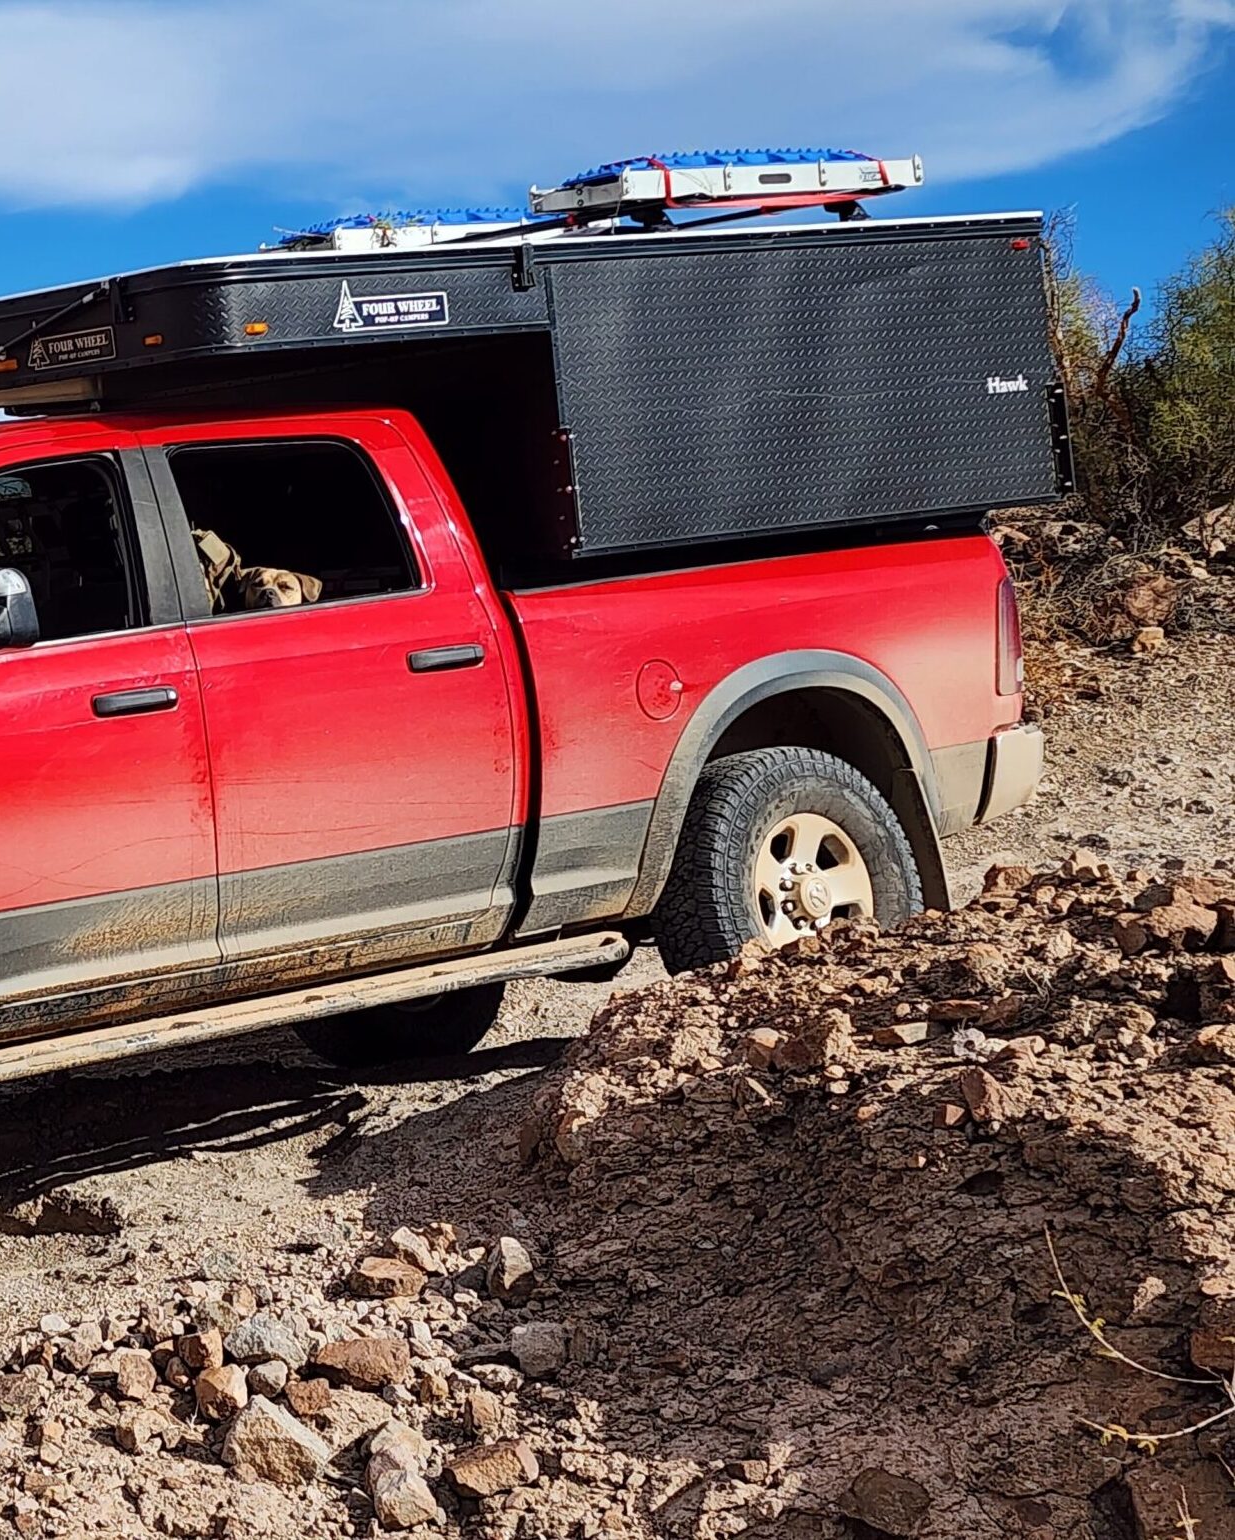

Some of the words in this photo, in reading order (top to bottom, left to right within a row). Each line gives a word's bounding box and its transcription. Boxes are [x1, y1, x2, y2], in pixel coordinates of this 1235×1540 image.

[362, 302, 395, 316] FOUR
[397, 299, 440, 313] WHEEL
[48, 340, 74, 354] FOUR
[75, 334, 109, 349] WHEEL
[986, 374, 1029, 394] Hawk
